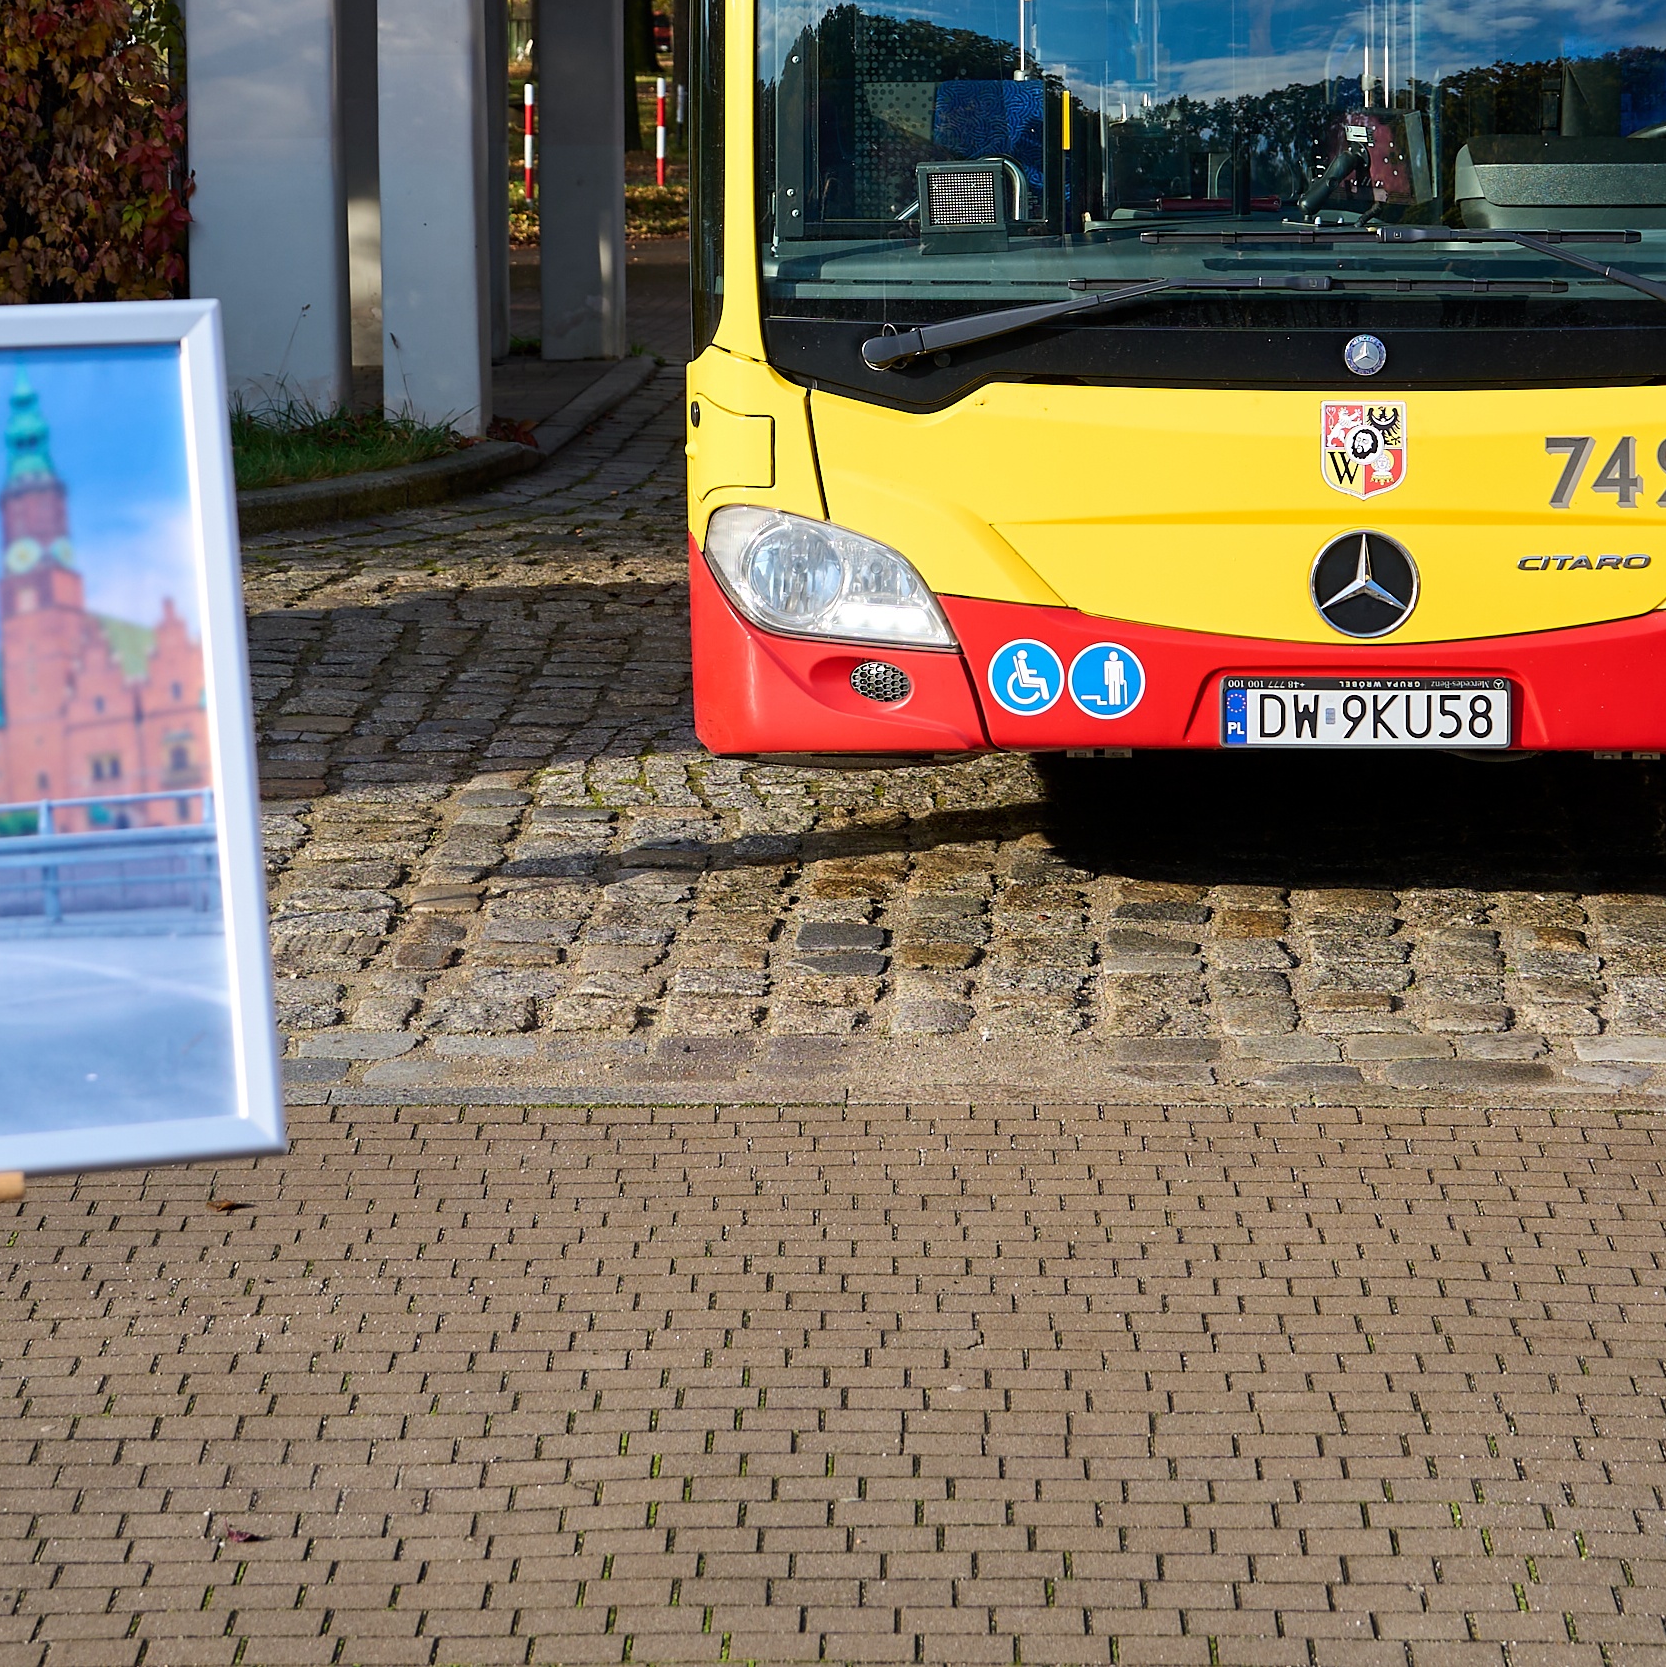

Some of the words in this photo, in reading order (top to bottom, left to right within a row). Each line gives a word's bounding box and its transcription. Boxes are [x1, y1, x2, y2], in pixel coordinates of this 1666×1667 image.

[1517, 553, 1652, 571] CITARO
[1228, 679, 1244, 688] 100
[1247, 679, 1264, 688] 100
[1267, 680, 1285, 689] 777
[1287, 680, 1306, 688] +48
[1338, 680, 1382, 690] WRÓBEL
[1386, 680, 1421, 688] GRUPA
[1430, 680, 1490, 689] Mercedes-Benz
[1259, 694, 1320, 738] DW
[1342, 694, 1493, 739] 9KU58
[1227, 722, 1245, 735] PL
